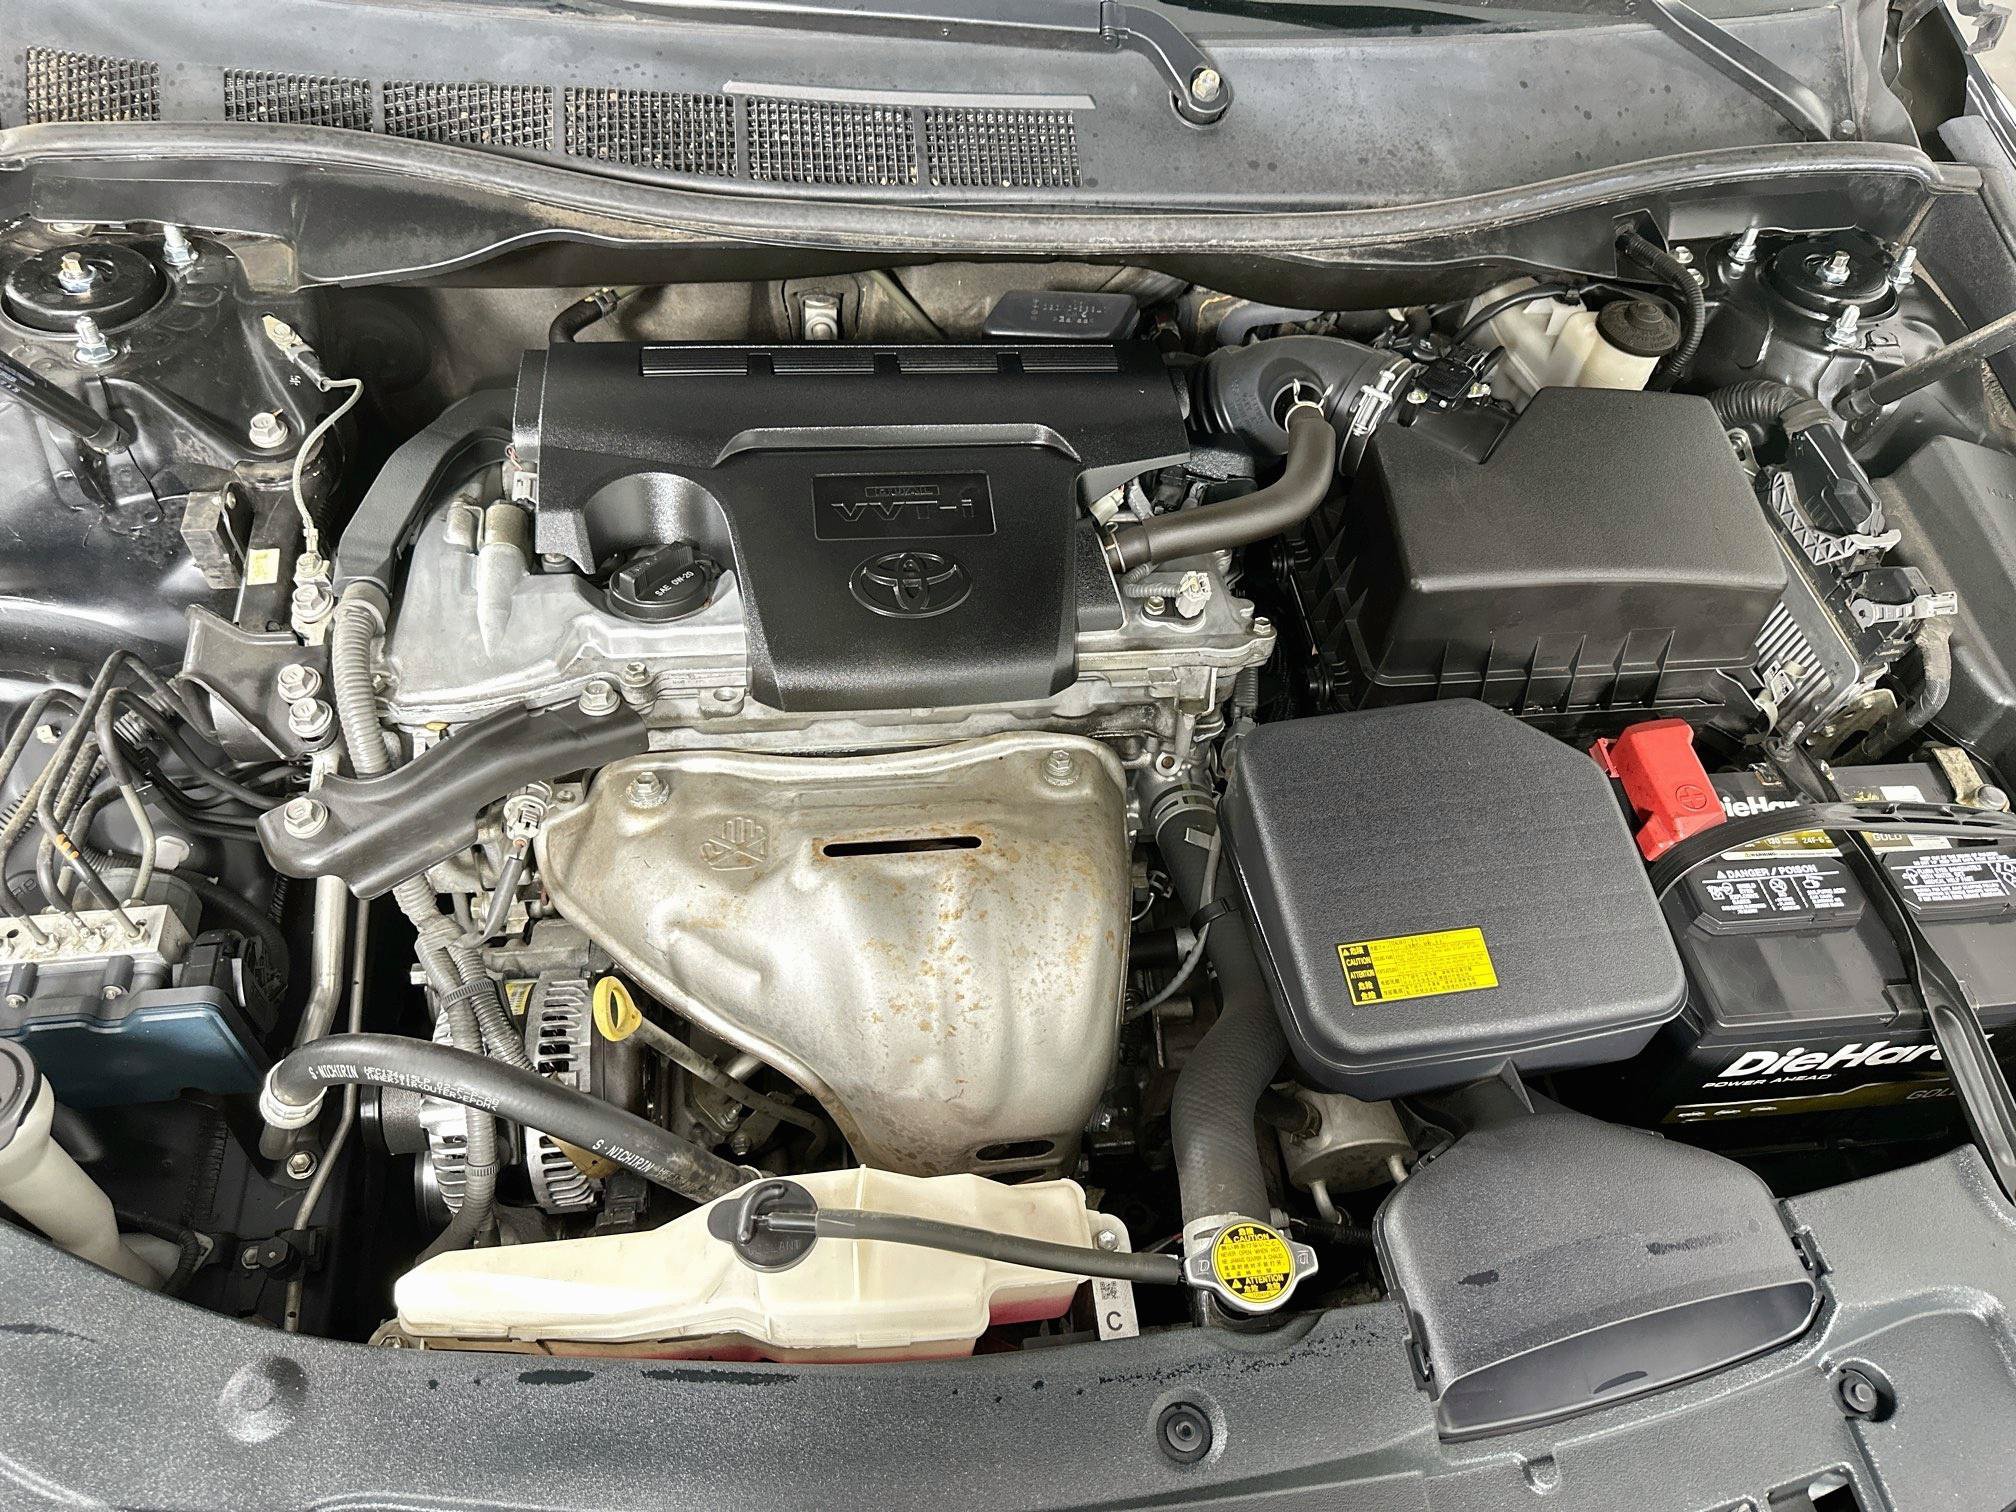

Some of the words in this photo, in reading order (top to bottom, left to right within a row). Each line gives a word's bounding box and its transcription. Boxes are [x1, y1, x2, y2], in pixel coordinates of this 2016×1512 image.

[831, 498, 974, 521] VVT-i
[655, 584, 672, 597] SAE
[1726, 867, 1770, 879] DANGER
[1777, 864, 1818, 875] POISON
[1345, 956, 1372, 967] CAUTION
[1350, 969, 1376, 979] ATTENTION
[1718, 1040, 1943, 1077] DieHar
[1702, 1079, 1767, 1088] POWER
[1769, 1074, 1833, 1084] AHEAD
[1233, 1233, 1270, 1242] CAUTION
[1245, 1274, 1284, 1285] ATTENTION
[1106, 1311, 1123, 1331] C
